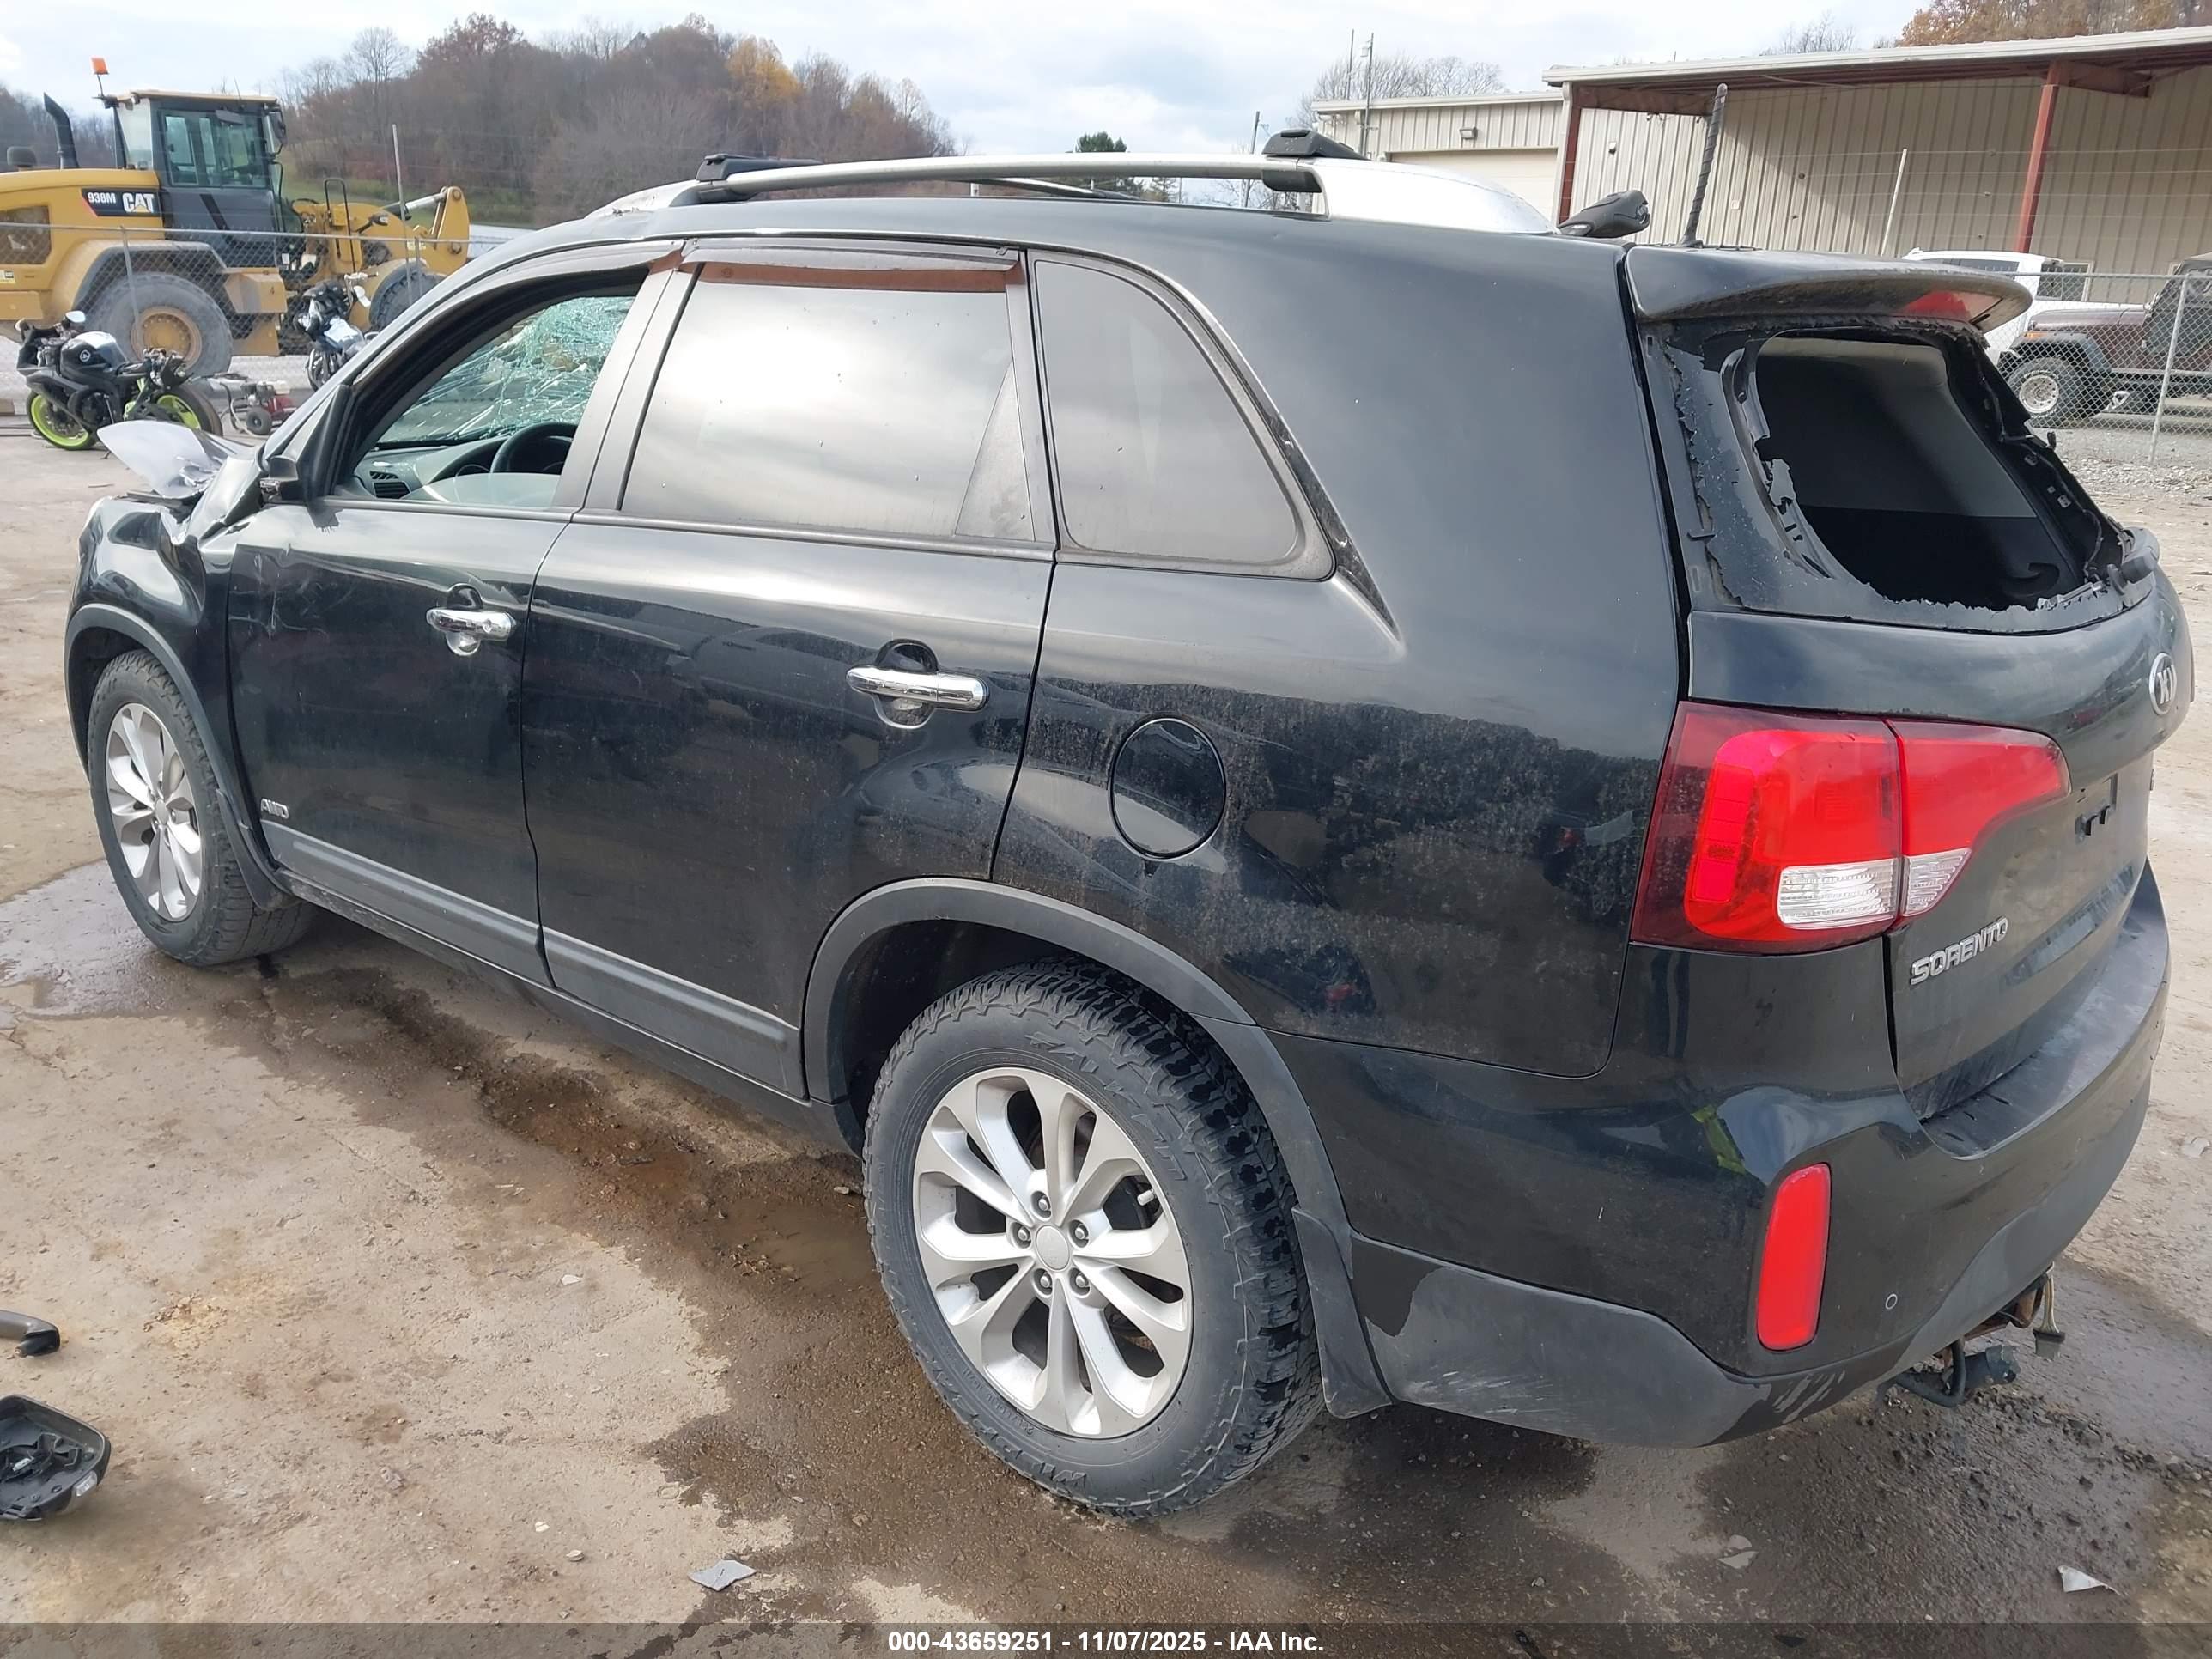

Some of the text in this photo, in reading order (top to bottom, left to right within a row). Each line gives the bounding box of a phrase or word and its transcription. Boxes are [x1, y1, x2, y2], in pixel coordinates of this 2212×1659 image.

[87, 191, 155, 213] 938M CAT
[261, 798, 289, 819] AWD
[1910, 915, 2009, 987] SORENTO
